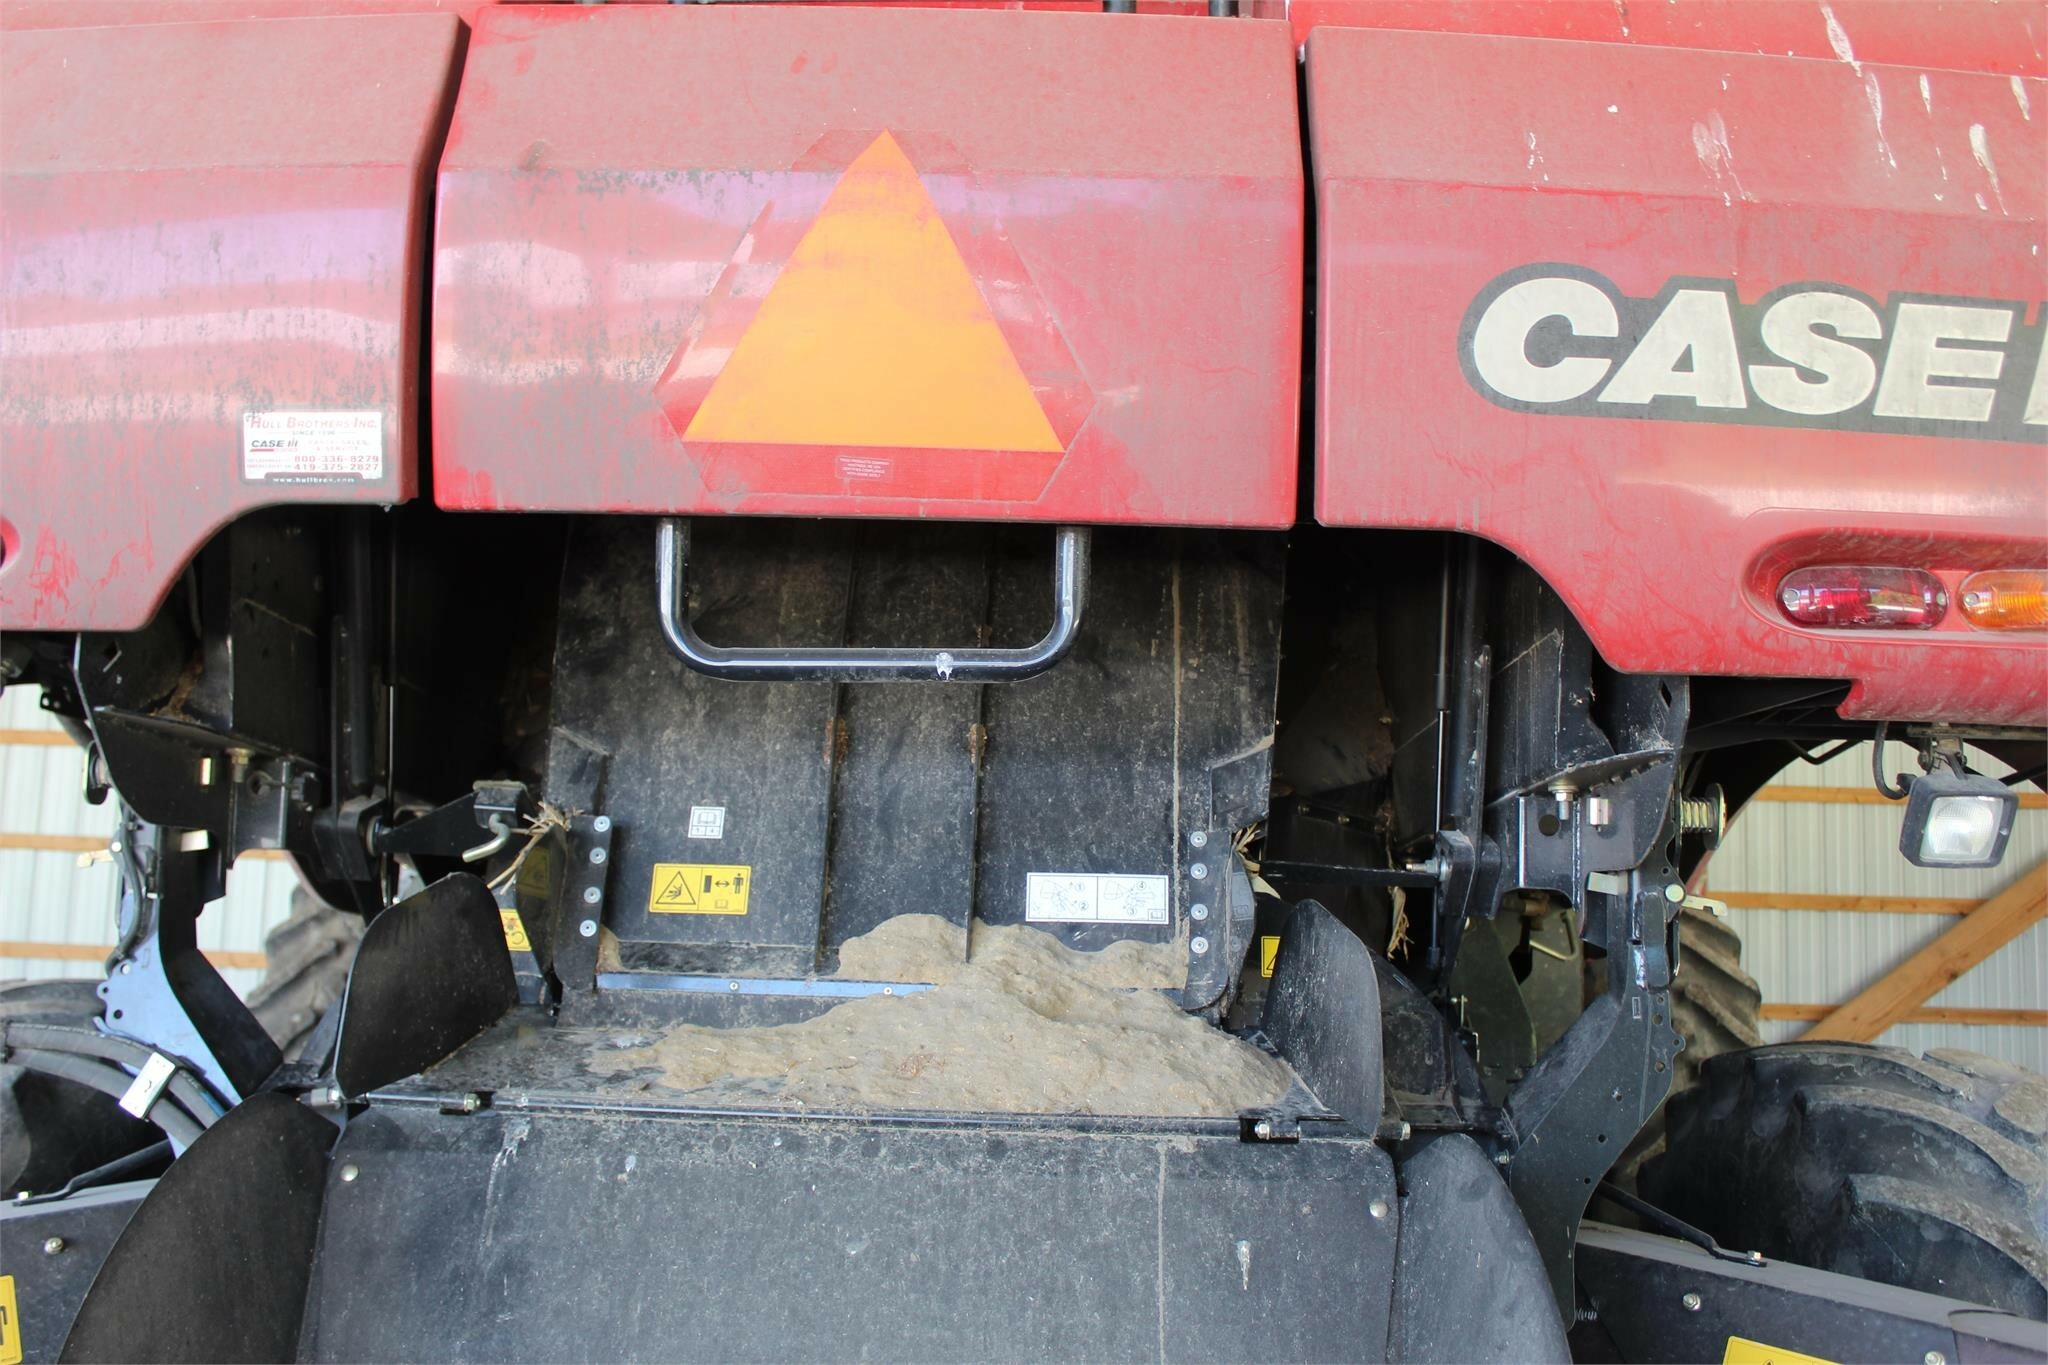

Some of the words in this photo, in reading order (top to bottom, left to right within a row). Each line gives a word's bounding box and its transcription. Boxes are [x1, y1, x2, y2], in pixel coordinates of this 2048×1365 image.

[1473, 276, 2014, 422] CASE
[287, 416, 350, 428] BROTHERS
[251, 440, 285, 448] CASE
